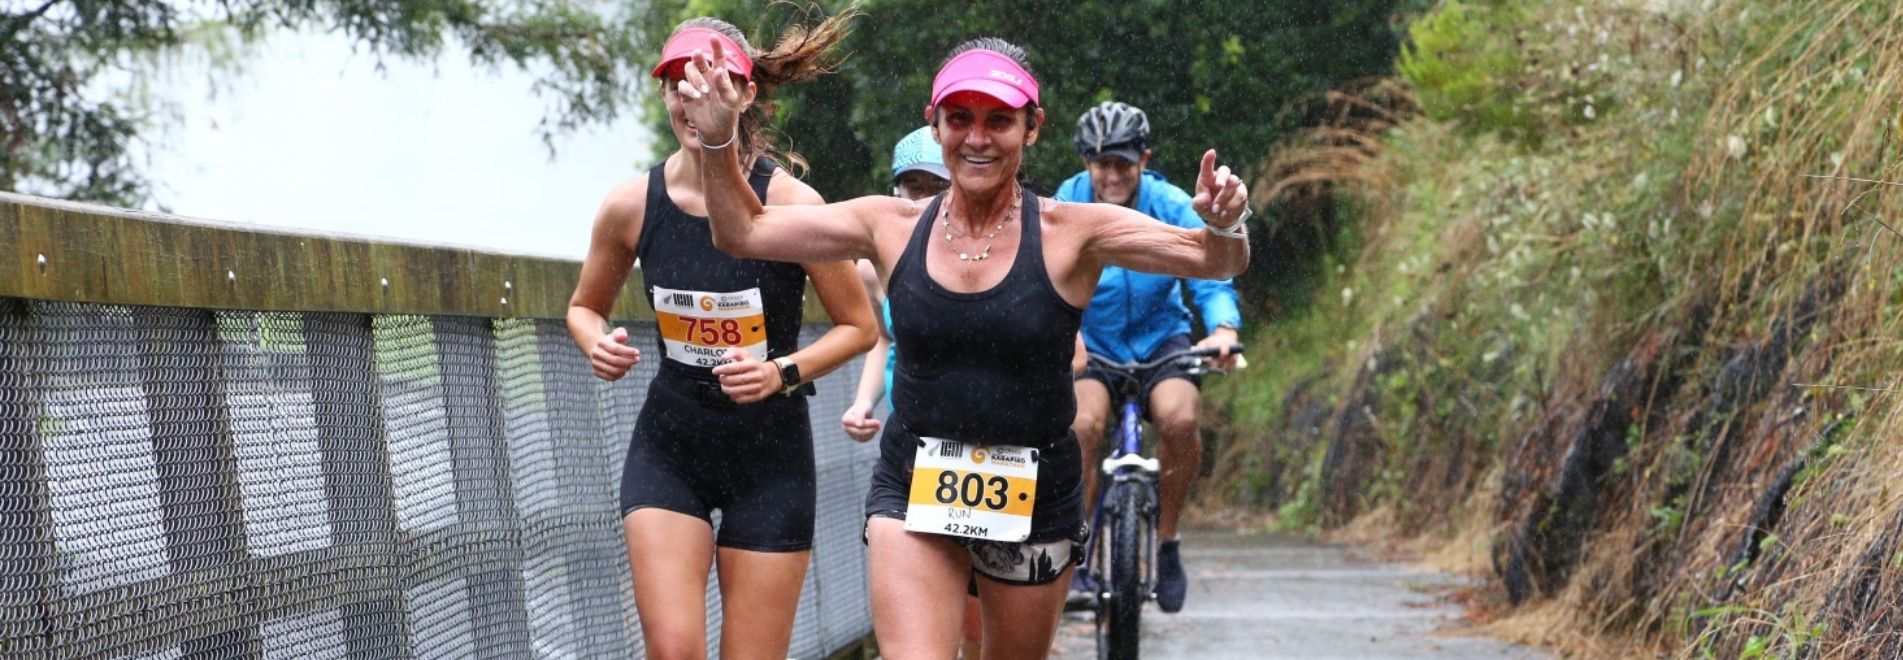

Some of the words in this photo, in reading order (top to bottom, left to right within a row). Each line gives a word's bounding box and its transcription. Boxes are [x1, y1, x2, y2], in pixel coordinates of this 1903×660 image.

[679, 316, 741, 345] 758
[684, 344, 727, 357] CHARLO
[936, 470, 1009, 510] 803
[948, 507, 972, 519] RUN
[944, 523, 988, 537] 42.2KM
